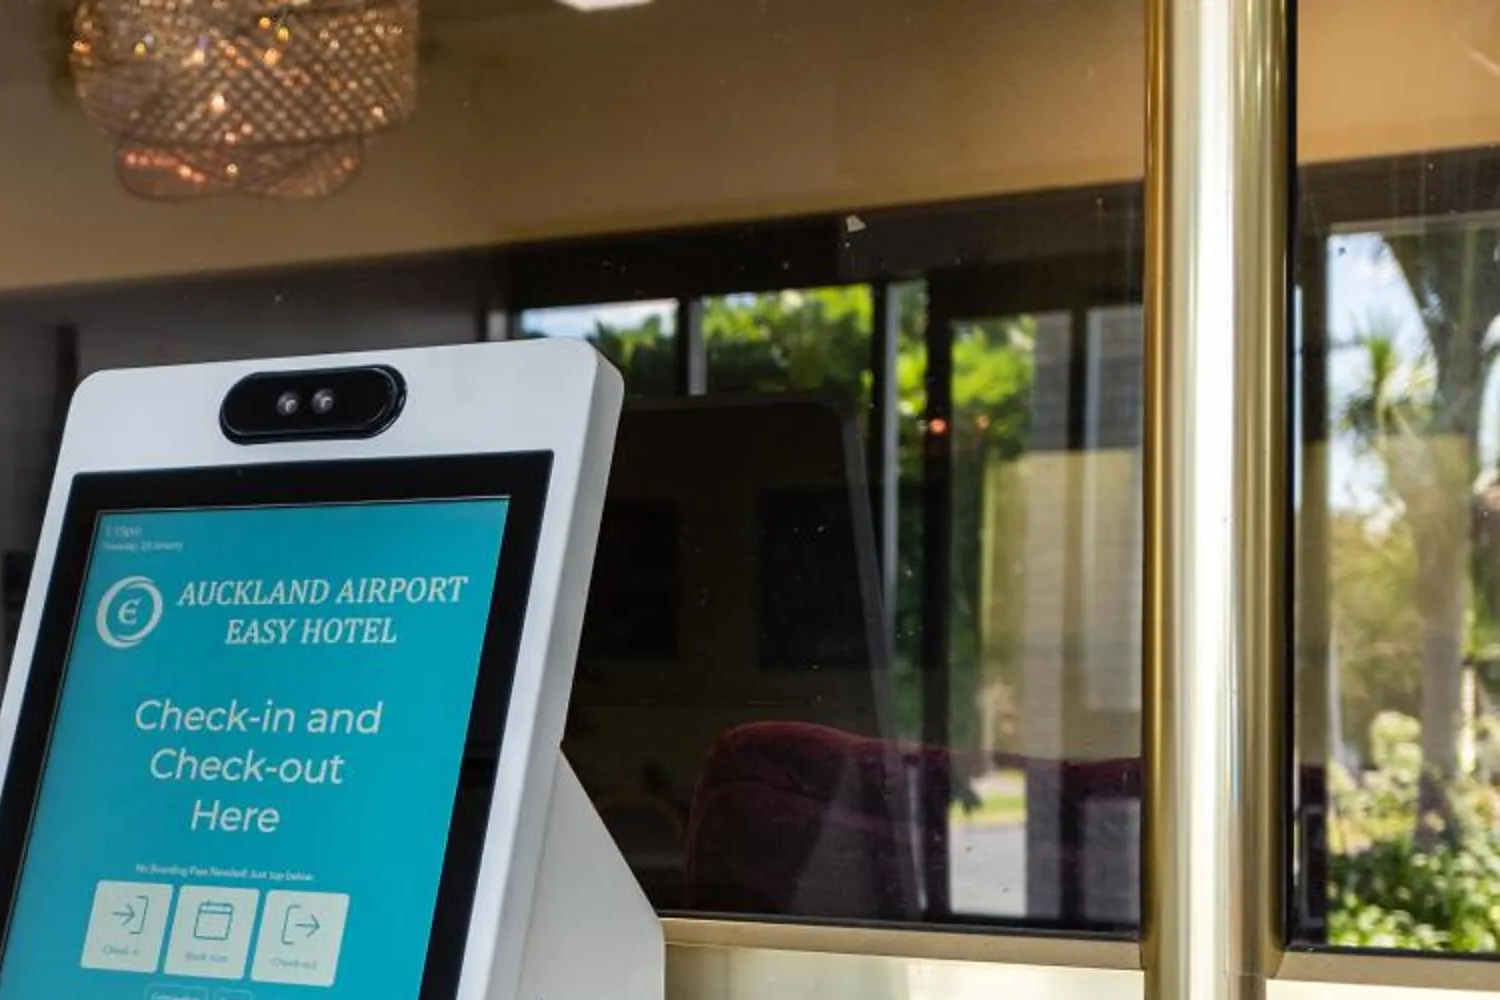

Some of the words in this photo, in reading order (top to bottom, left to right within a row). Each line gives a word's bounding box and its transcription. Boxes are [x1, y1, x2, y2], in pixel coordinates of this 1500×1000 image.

[177, 580, 329, 607] AUCKLAND
[335, 576, 469, 605] AIRPORT
[225, 618, 296, 645] EASY
[300, 617, 398, 645] HOTEL
[135, 698, 296, 734] Check-in
[307, 701, 383, 735] and
[150, 747, 345, 785] Check-out
[190, 799, 280, 833] Here
